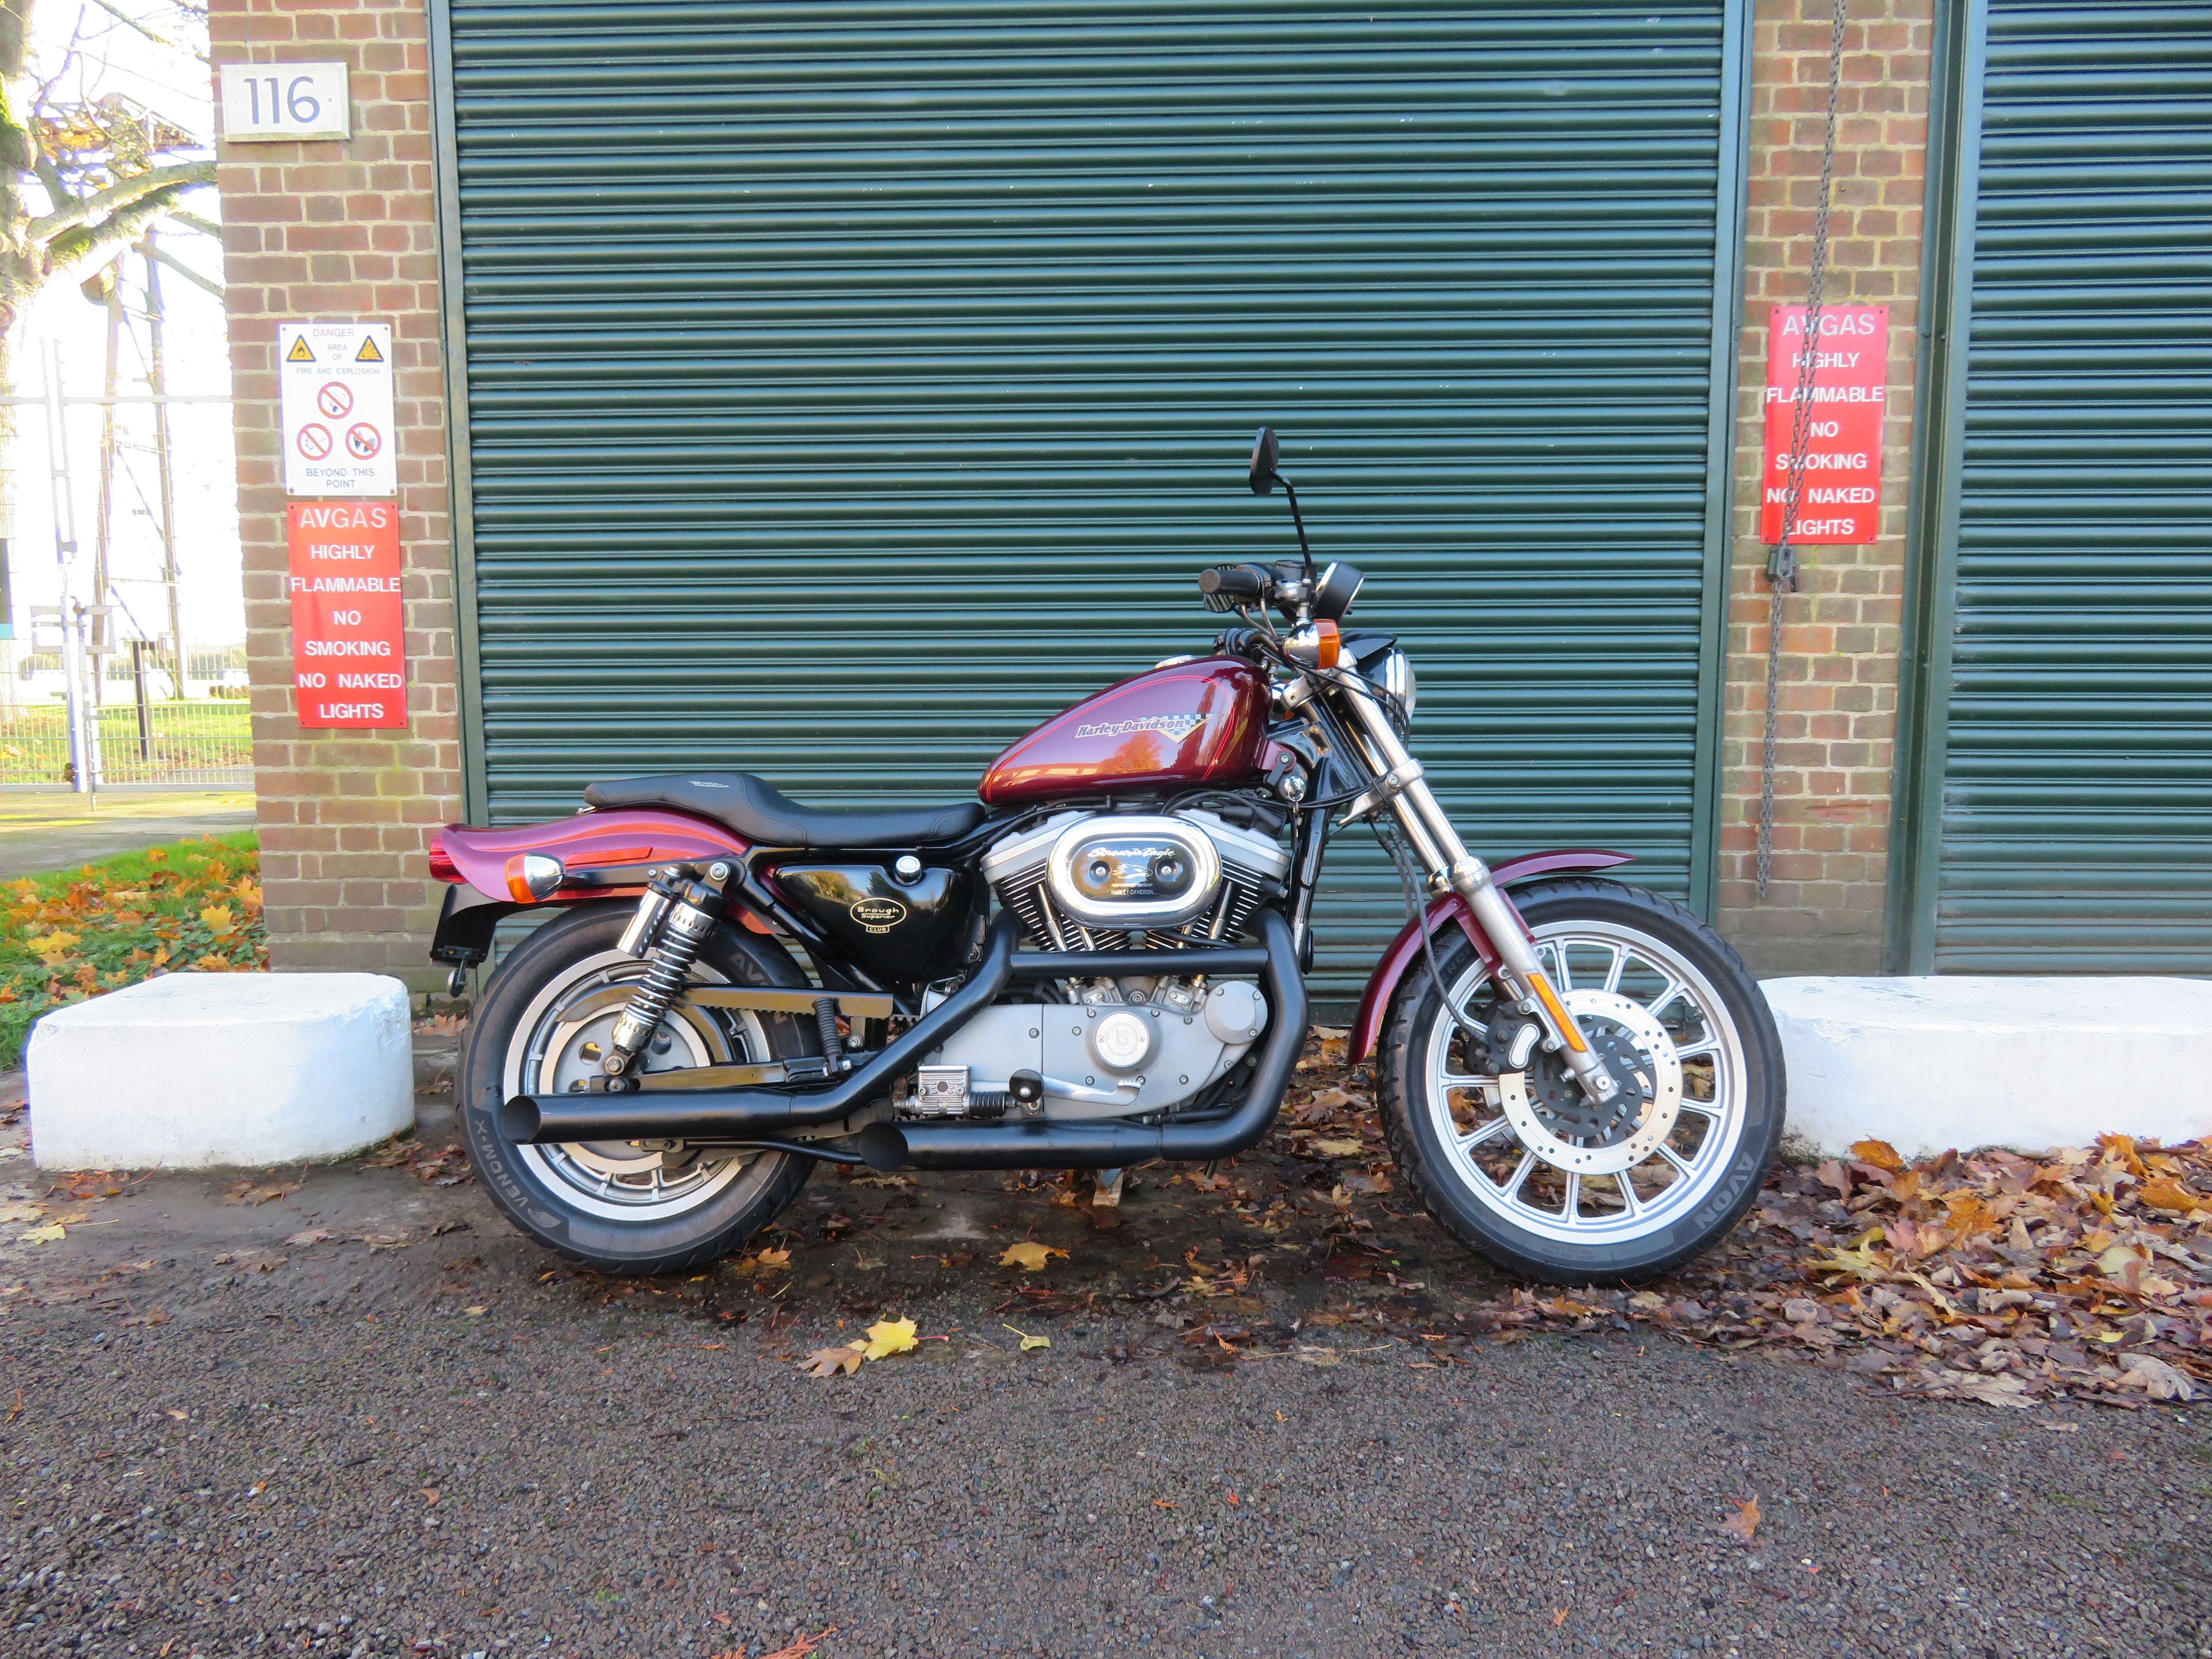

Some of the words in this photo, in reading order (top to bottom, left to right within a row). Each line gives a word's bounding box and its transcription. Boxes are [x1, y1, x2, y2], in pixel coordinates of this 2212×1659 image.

[244, 76, 320, 124] 116
[313, 328, 354, 337] DANGER
[1810, 422, 1839, 437] NO
[306, 468, 347, 476] BEYOND
[353, 468, 374, 476] THIS
[1808, 488, 1875, 504] NAKED
[300, 508, 387, 528] AVGAS
[310, 544, 375, 559] HIGHLY
[291, 577, 401, 592] FLAMMABLE
[333, 611, 361, 626] NO
[305, 641, 391, 656] SMOKING
[299, 673, 326, 688] NO
[339, 673, 402, 689] NAKED
[319, 704, 384, 719] LIGHTS
[1075, 718, 1185, 737] Harley-Davidson
[1142, 847, 1176, 859] Eagle
[857, 906, 899, 914] Brough
[1693, 1150, 1755, 1230] AVON
